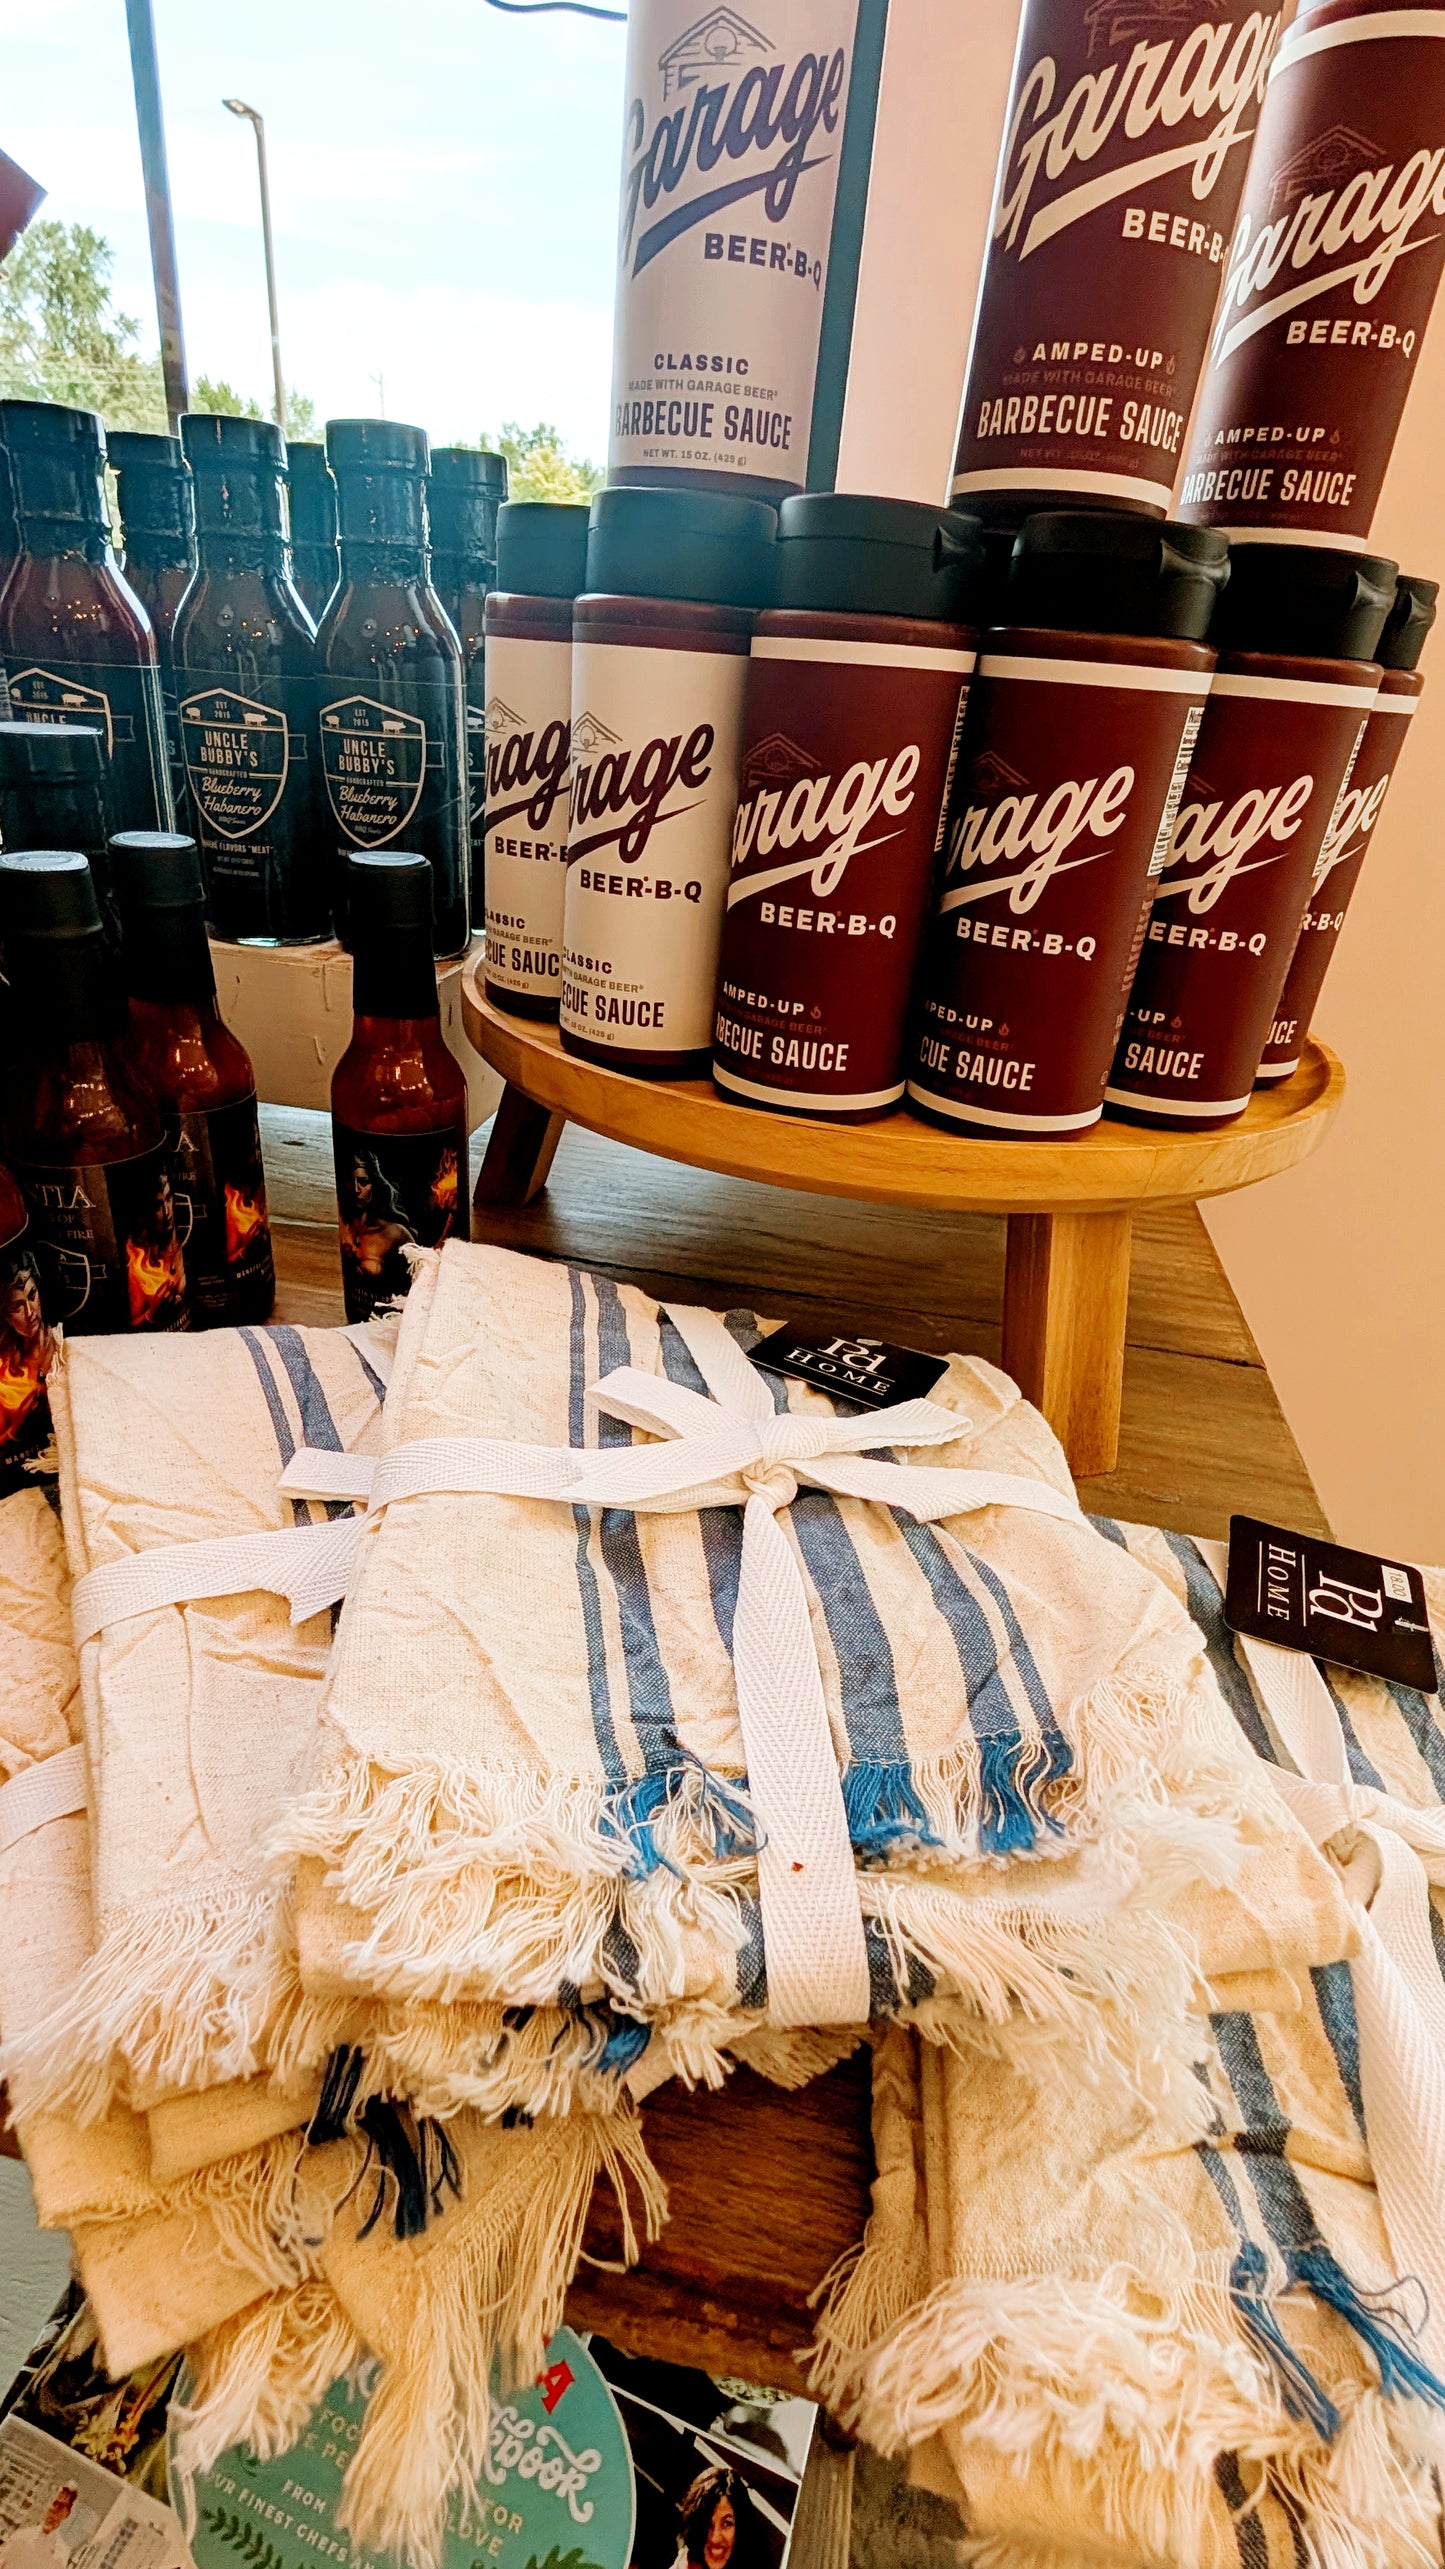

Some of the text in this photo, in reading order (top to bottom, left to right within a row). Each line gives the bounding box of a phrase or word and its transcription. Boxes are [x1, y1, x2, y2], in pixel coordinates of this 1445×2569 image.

[622, 47, 845, 280] Garage
[1121, 208, 1229, 264] BEER-B-
[654, 353, 749, 376] CLASSIC
[1032, 342, 1164, 370] AMPED-UP
[628, 379, 653, 392] MADE
[654, 379, 684, 390] WITH
[687, 380, 741, 396] GARAGE
[1084, 371, 1142, 390] GARAGE
[615, 400, 793, 451] BARBECUE SAUCE
[976, 394, 1184, 454] BARBECUE SAUCE
[1214, 426, 1326, 446] AMPED-UP
[680, 450, 693, 460] 15
[1280, 469, 1357, 506] SAUCE
[204, 730, 248, 750] UNCLE
[343, 738, 386, 758] UNCLE
[200, 746, 259, 768] BUBBY'S
[338, 754, 395, 776] BUBBY'S
[201, 776, 262, 803] Blueberry
[339, 785, 399, 812] Blueberry
[568, 723, 714, 869] rage
[203, 796, 262, 817] Habanero
[340, 804, 398, 826] Habanero
[727, 744, 921, 913] arage
[939, 765, 1135, 916] rage
[486, 910, 526, 930] LASSIC
[1148, 920, 1267, 956] EER-B-Q
[511, 947, 560, 978] SAUC
[573, 972, 606, 989] GARAGE
[595, 994, 665, 1028] SAUCE
[723, 980, 805, 1016] AMPED-UP
[925, 1000, 993, 1031] PED-UP
[771, 1036, 850, 1072] SAUCE
[1125, 1042, 1205, 1079] SAUCE
[955, 1050, 1036, 1091] SAUCE
[786, 1349, 891, 1393] HOME
[1266, 1543, 1297, 1621] HOME
[282, 2478, 326, 2514] FROM
[237, 2487, 294, 2530] FINEST
[296, 2522, 349, 2563] CHEFS
